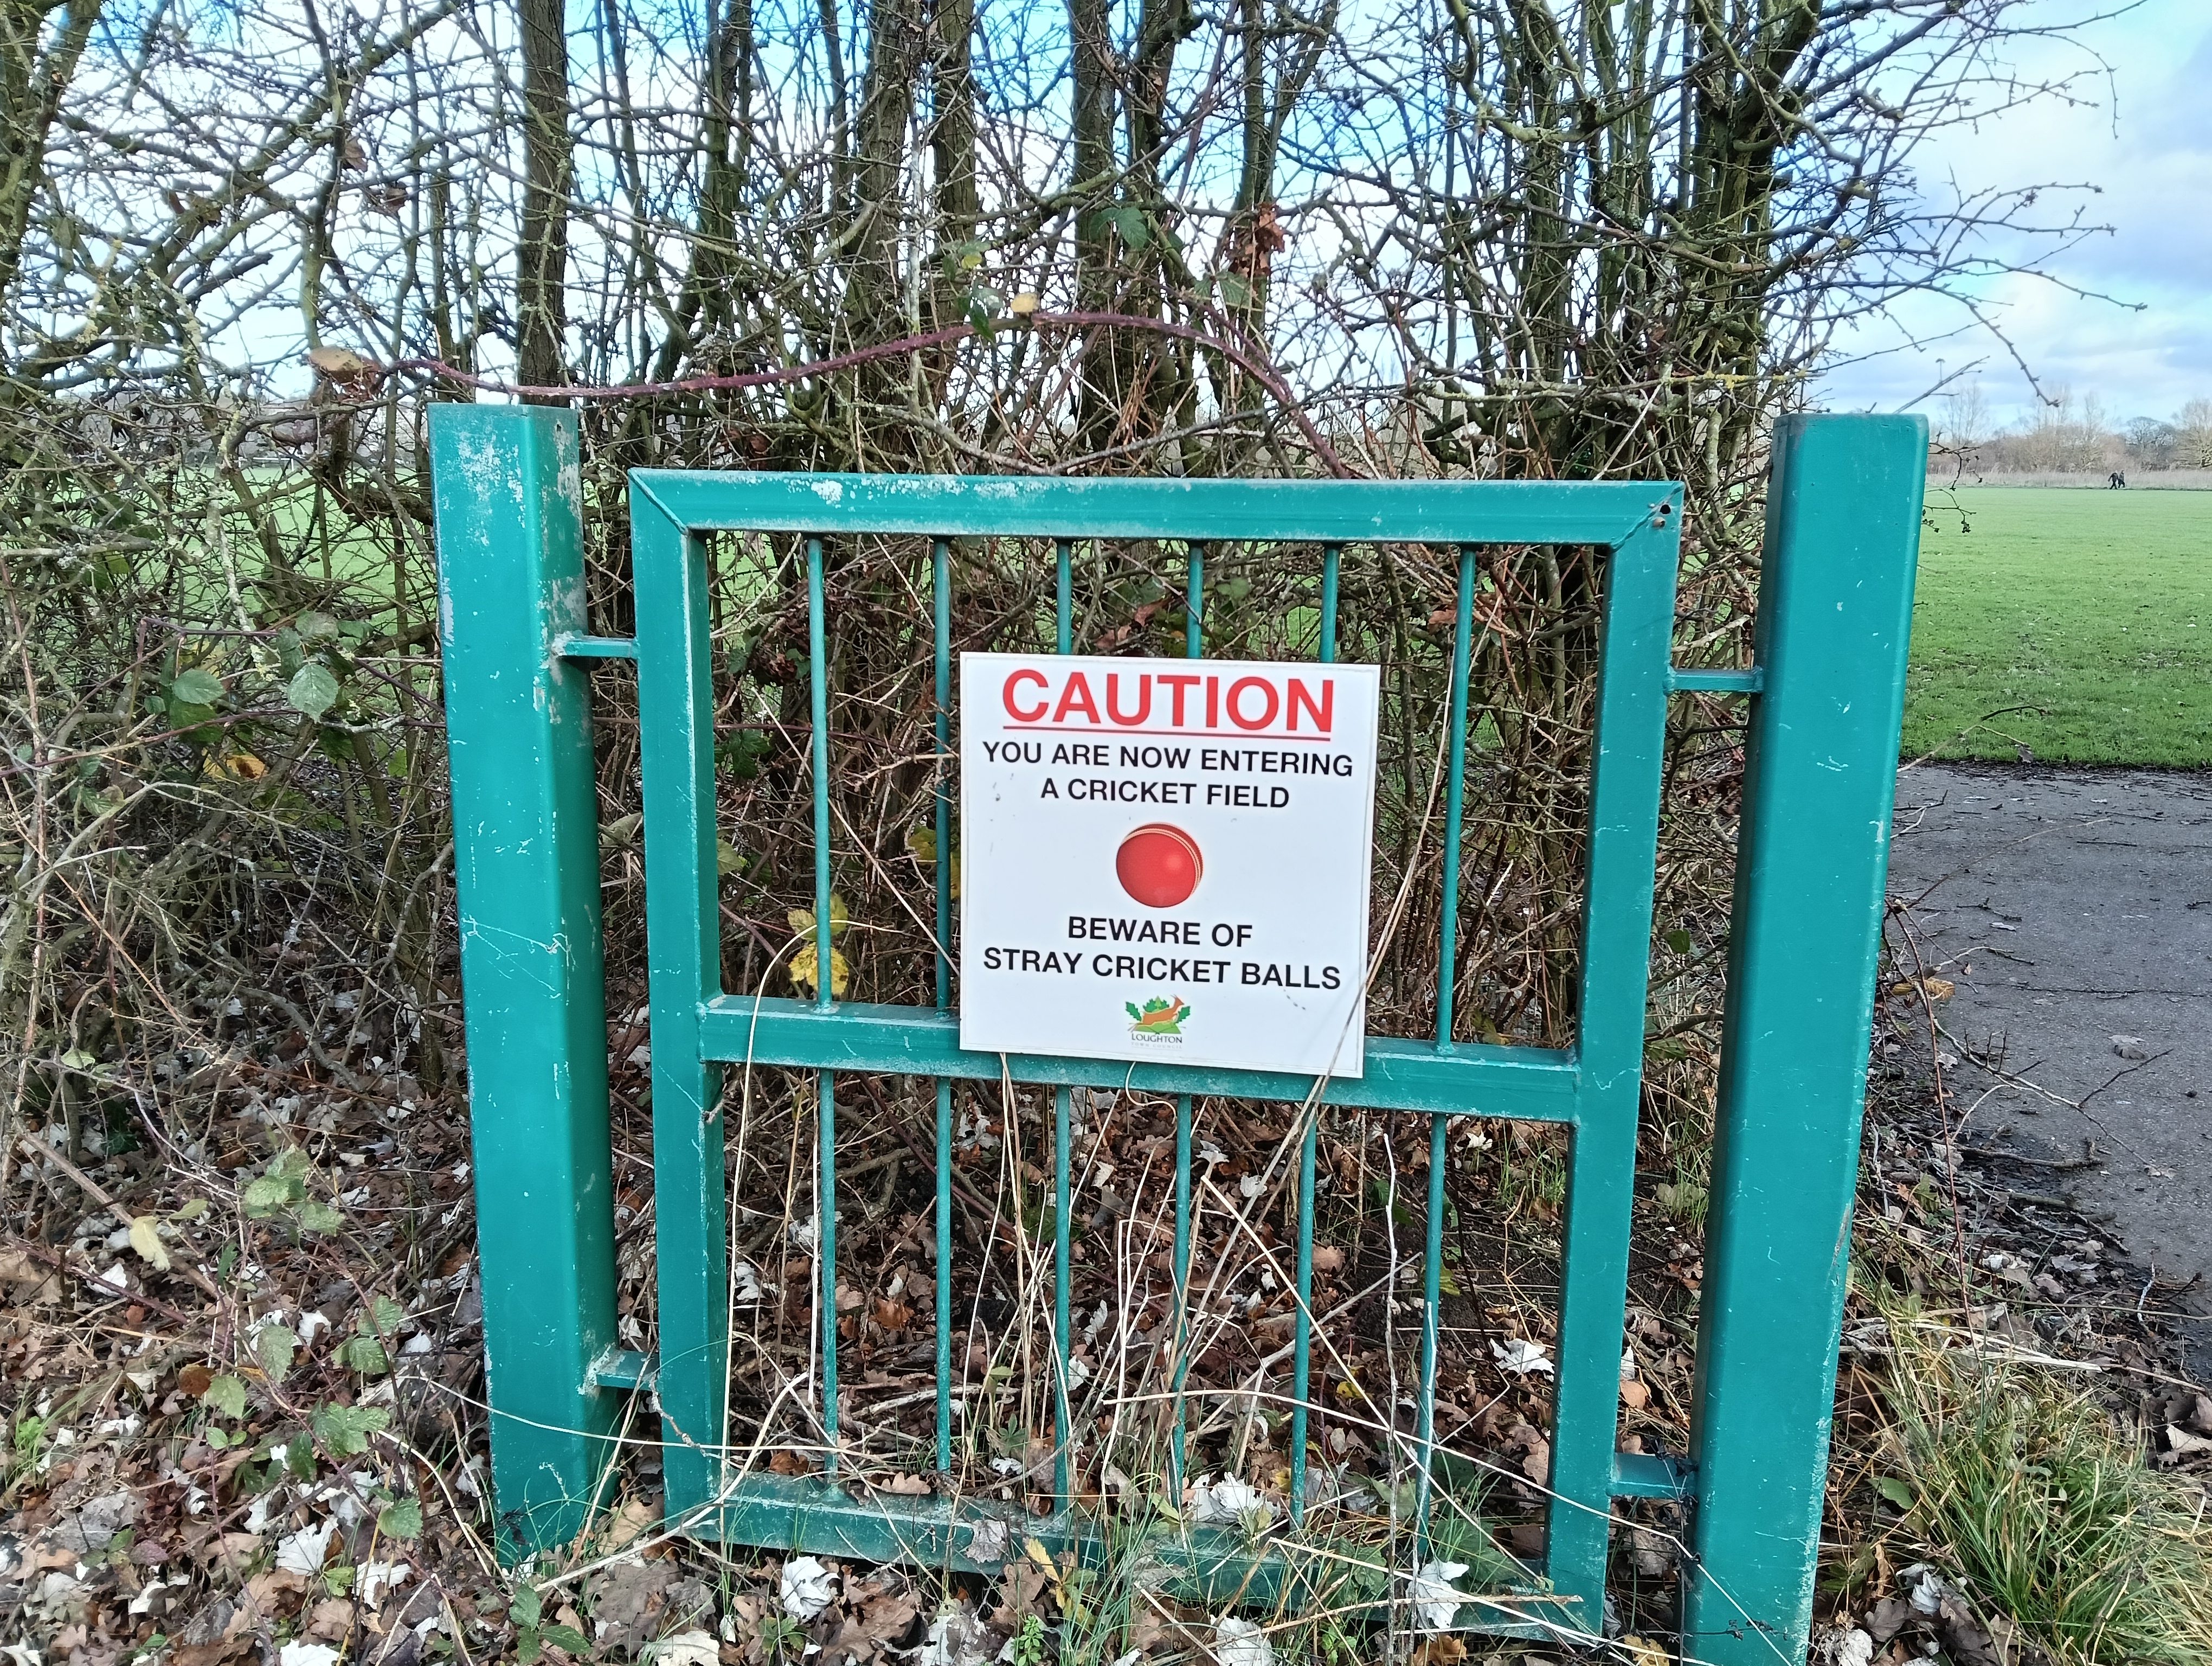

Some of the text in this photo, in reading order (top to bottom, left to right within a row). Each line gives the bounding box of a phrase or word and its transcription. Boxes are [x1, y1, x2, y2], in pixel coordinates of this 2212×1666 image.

[1002, 669, 1334, 732] CAUTION
[982, 741, 1353, 777] YOU ARE NOW ENTERING
[1041, 778, 1289, 808] A CRICKET FIELD
[1069, 916, 1252, 947] BEWARE OF
[983, 947, 1340, 990] STRAY CRICKET BALLS
[1131, 1033, 1182, 1043] LOUGHTON
